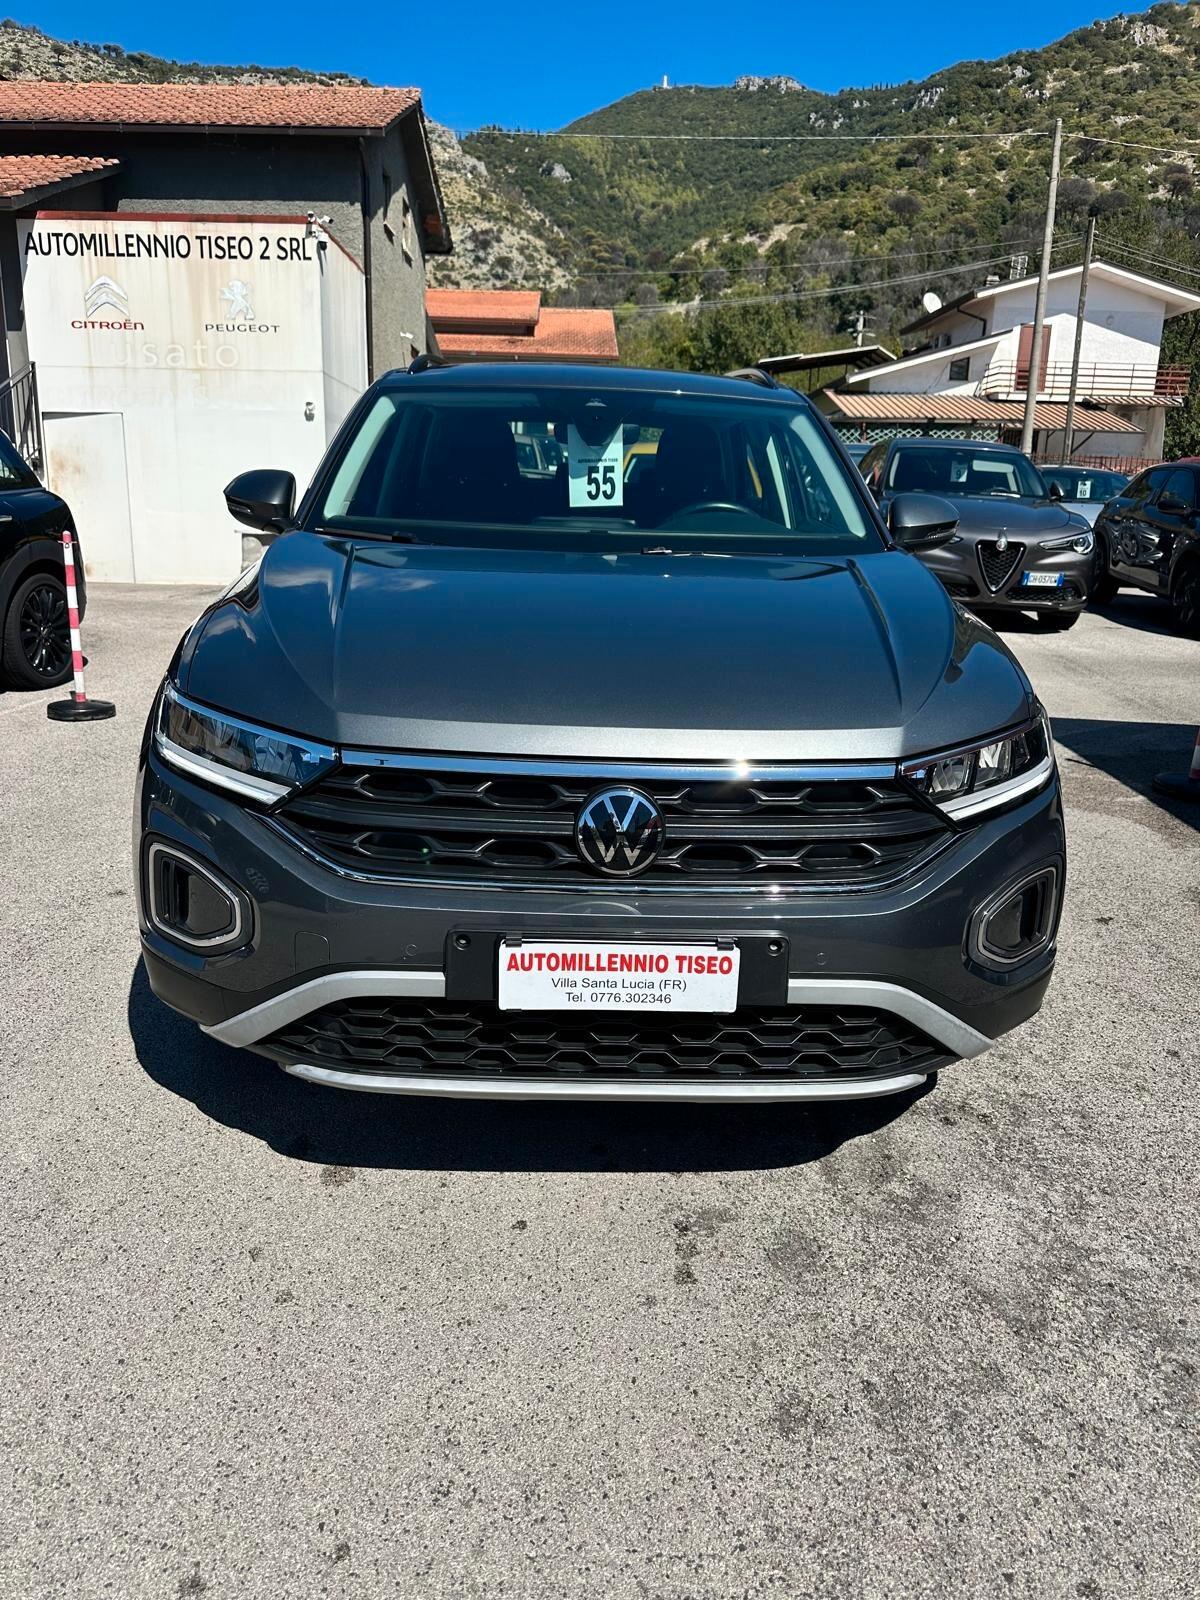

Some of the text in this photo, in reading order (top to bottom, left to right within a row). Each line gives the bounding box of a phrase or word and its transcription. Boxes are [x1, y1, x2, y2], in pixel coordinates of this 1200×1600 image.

[25, 231, 312, 261] AUTOMILLENNIO TISEO 2 SRL
[205, 323, 280, 334] PEUGEOT
[111, 338, 241, 368] usato
[586, 465, 617, 501] 55
[506, 952, 733, 975] AUTOMILLENNIO TISEO
[551, 977, 687, 992] Villa Santa Lucia (FR)
[565, 992, 672, 1004] Tel. 0776.302346
